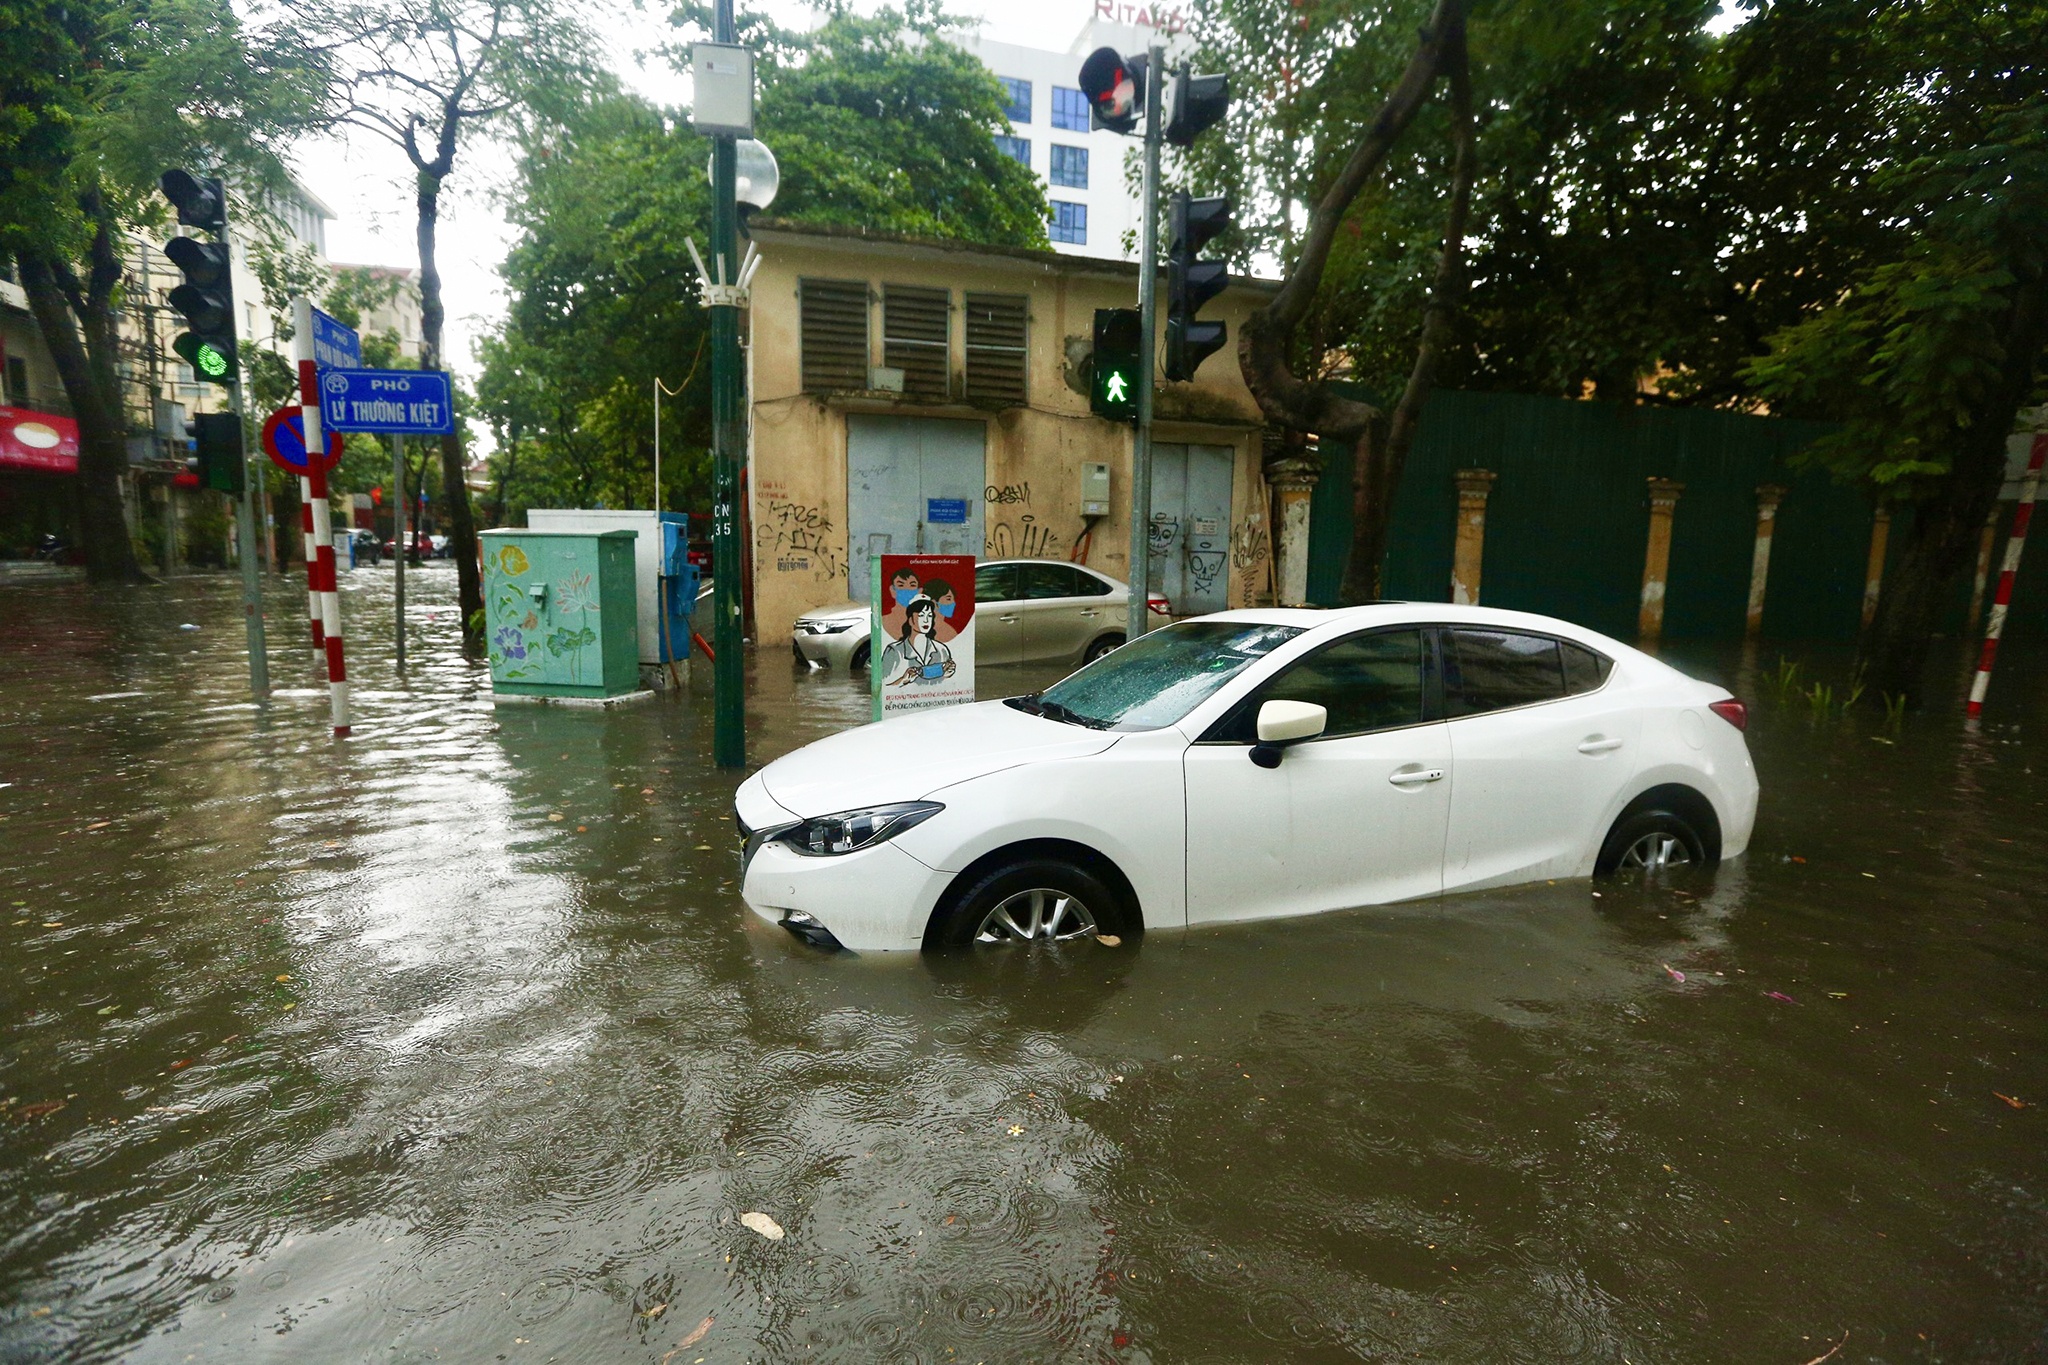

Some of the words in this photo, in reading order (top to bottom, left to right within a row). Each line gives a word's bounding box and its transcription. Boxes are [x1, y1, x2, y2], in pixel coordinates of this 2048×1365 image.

[371, 376, 410, 392] PHỐ
[332, 396, 346, 421] LÝ
[351, 397, 405, 423] THƯỜNG
[410, 398, 439, 428] KIỆT
[715, 522, 731, 536] 35
